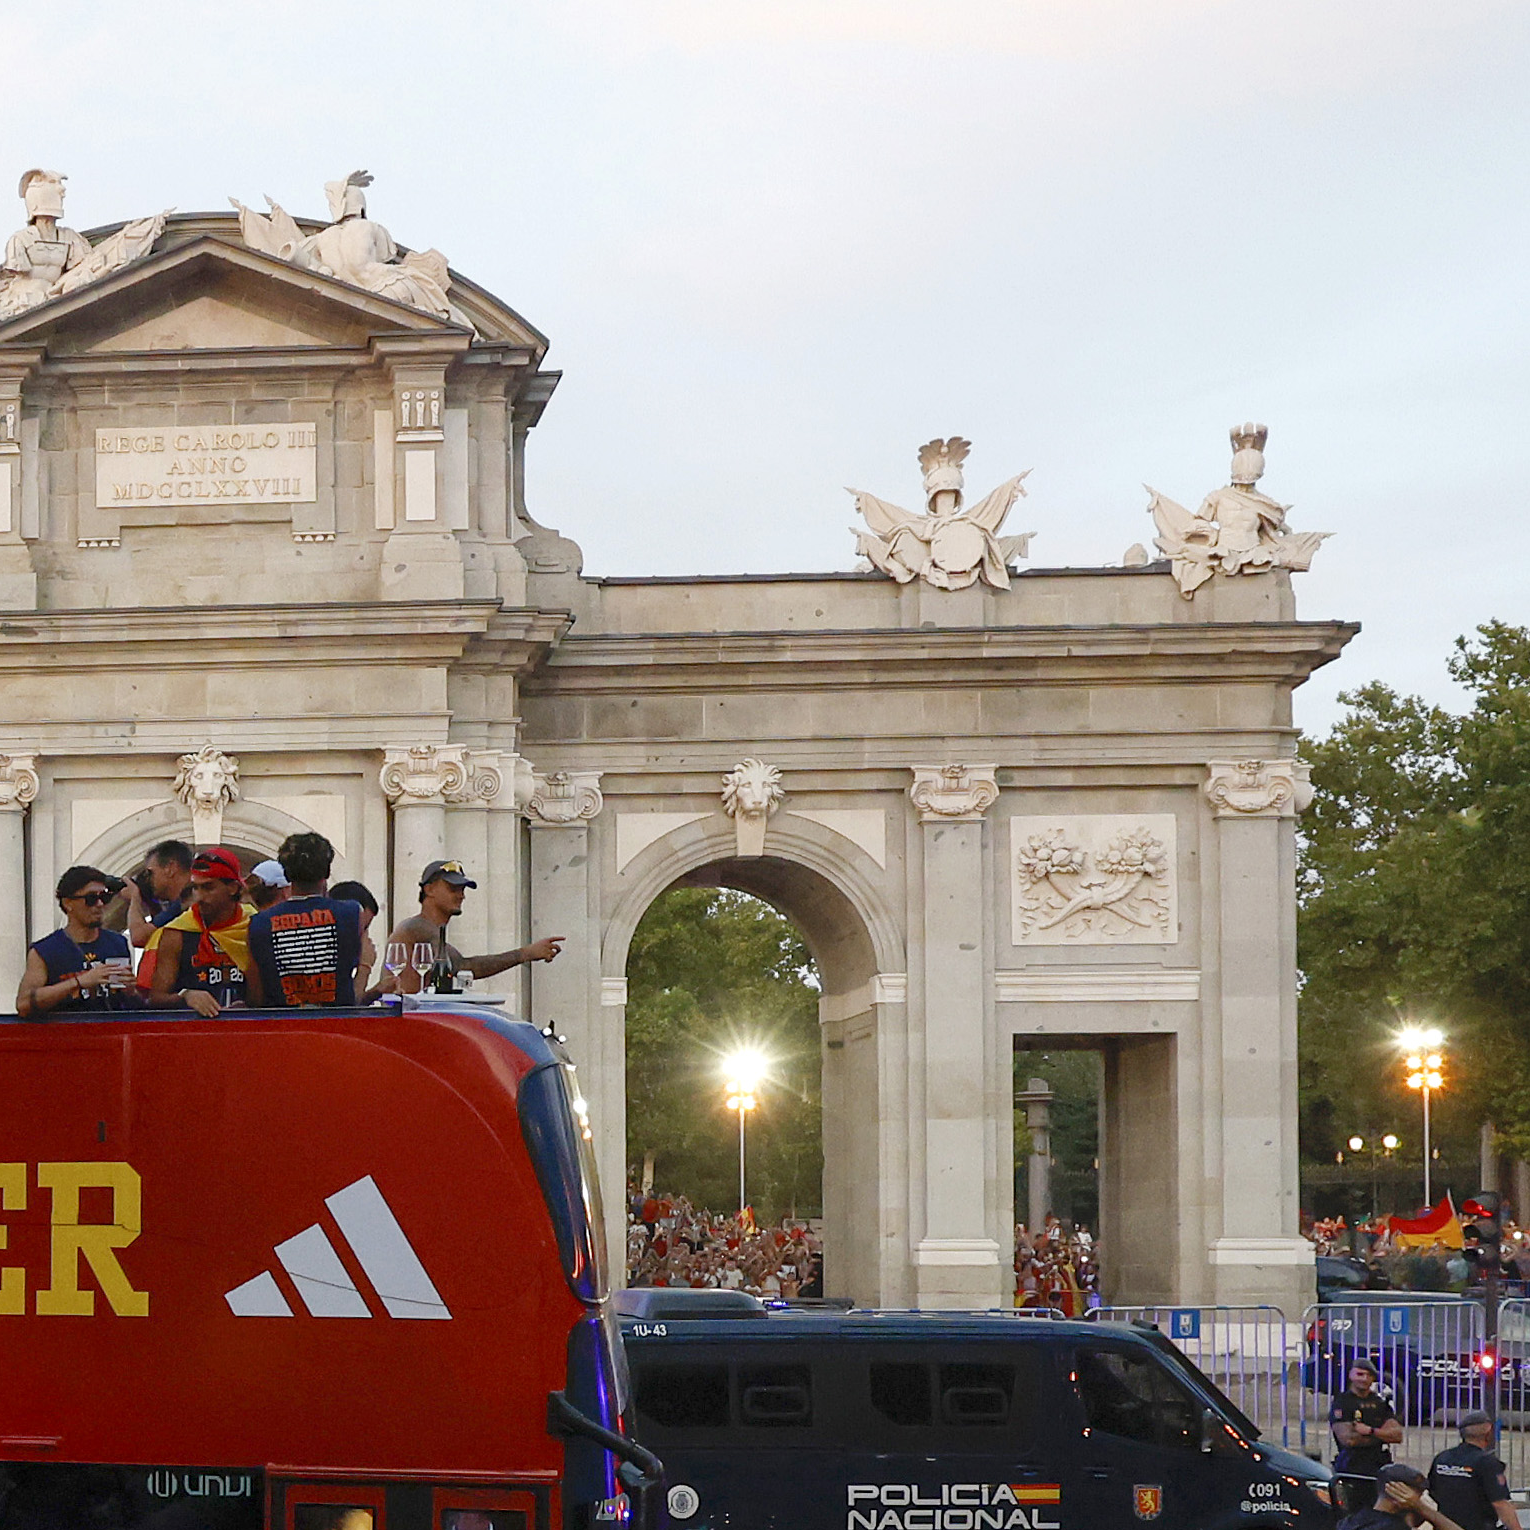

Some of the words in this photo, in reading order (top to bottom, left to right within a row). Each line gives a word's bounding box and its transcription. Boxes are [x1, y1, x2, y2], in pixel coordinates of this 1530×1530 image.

[98, 436, 164, 455] REGE
[173, 432, 280, 453] CAROLO
[286, 430, 316, 450] III
[166, 456, 249, 476] ANNO
[111, 478, 302, 500] MDCCLXXVIII
[1256, 1483, 1281, 1497] 091
[847, 1507, 1060, 1530] NACIONAL
